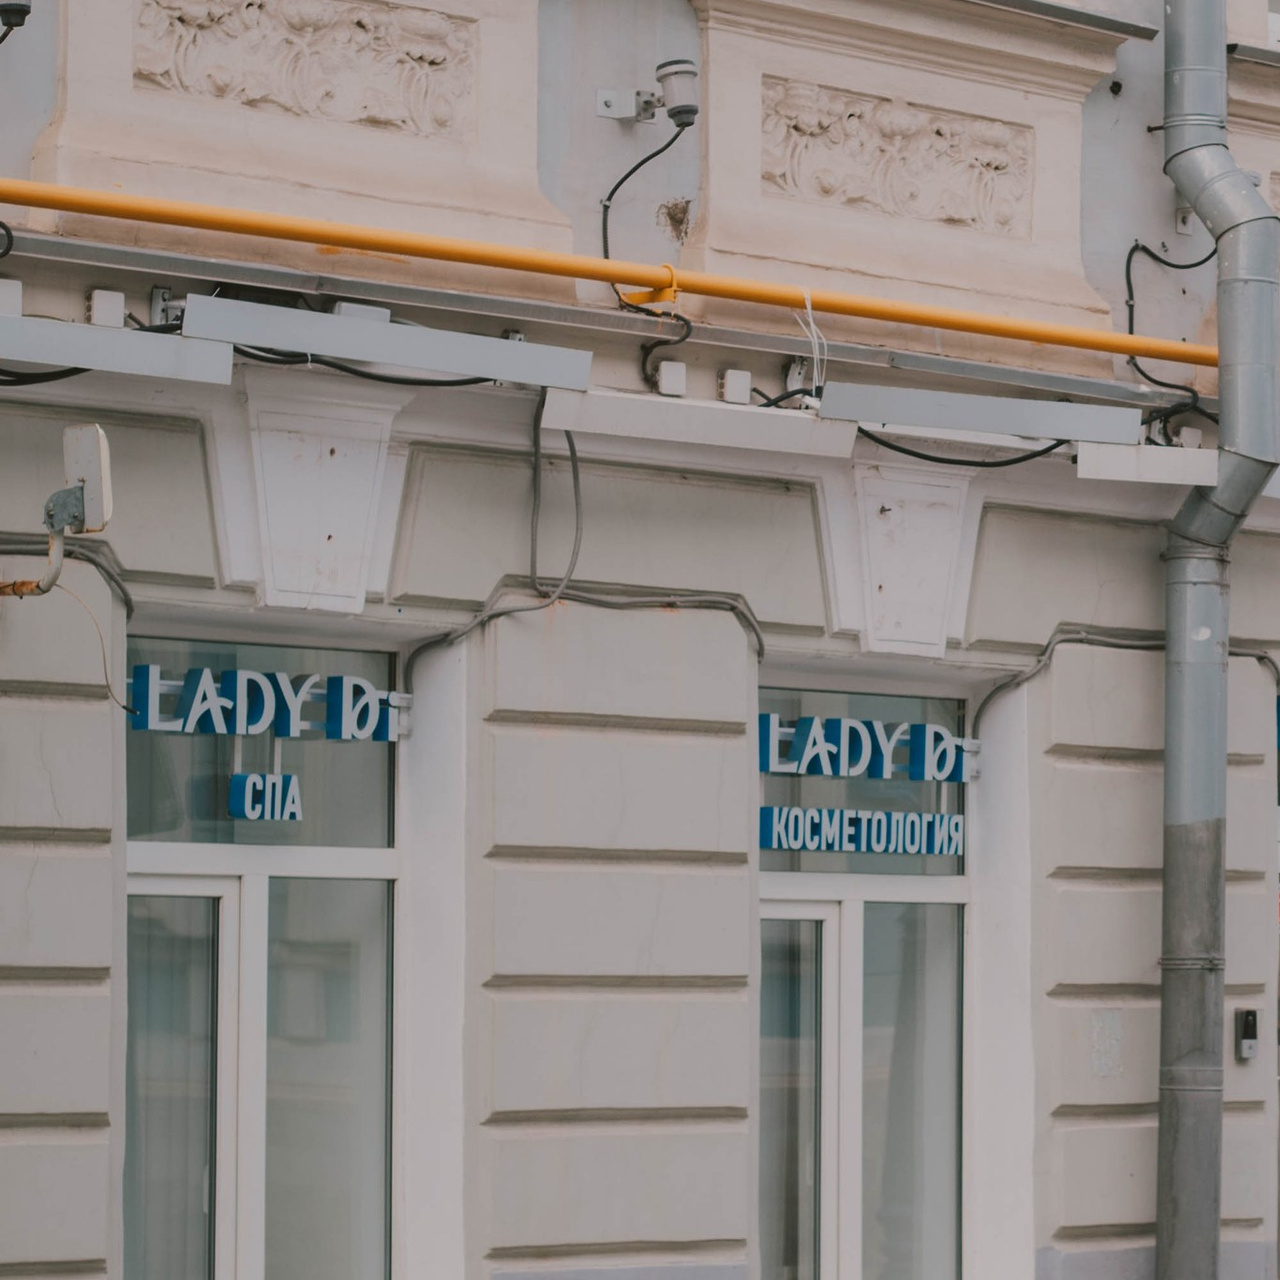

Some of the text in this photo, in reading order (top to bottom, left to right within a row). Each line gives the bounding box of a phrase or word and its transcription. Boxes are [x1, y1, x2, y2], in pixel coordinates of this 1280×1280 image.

[147, 664, 321, 738] LADY
[768, 713, 909, 780] LADY
[243, 773, 303, 821] СПА
[772, 806, 964, 856] КОСМЕТОЛОГИЯ
